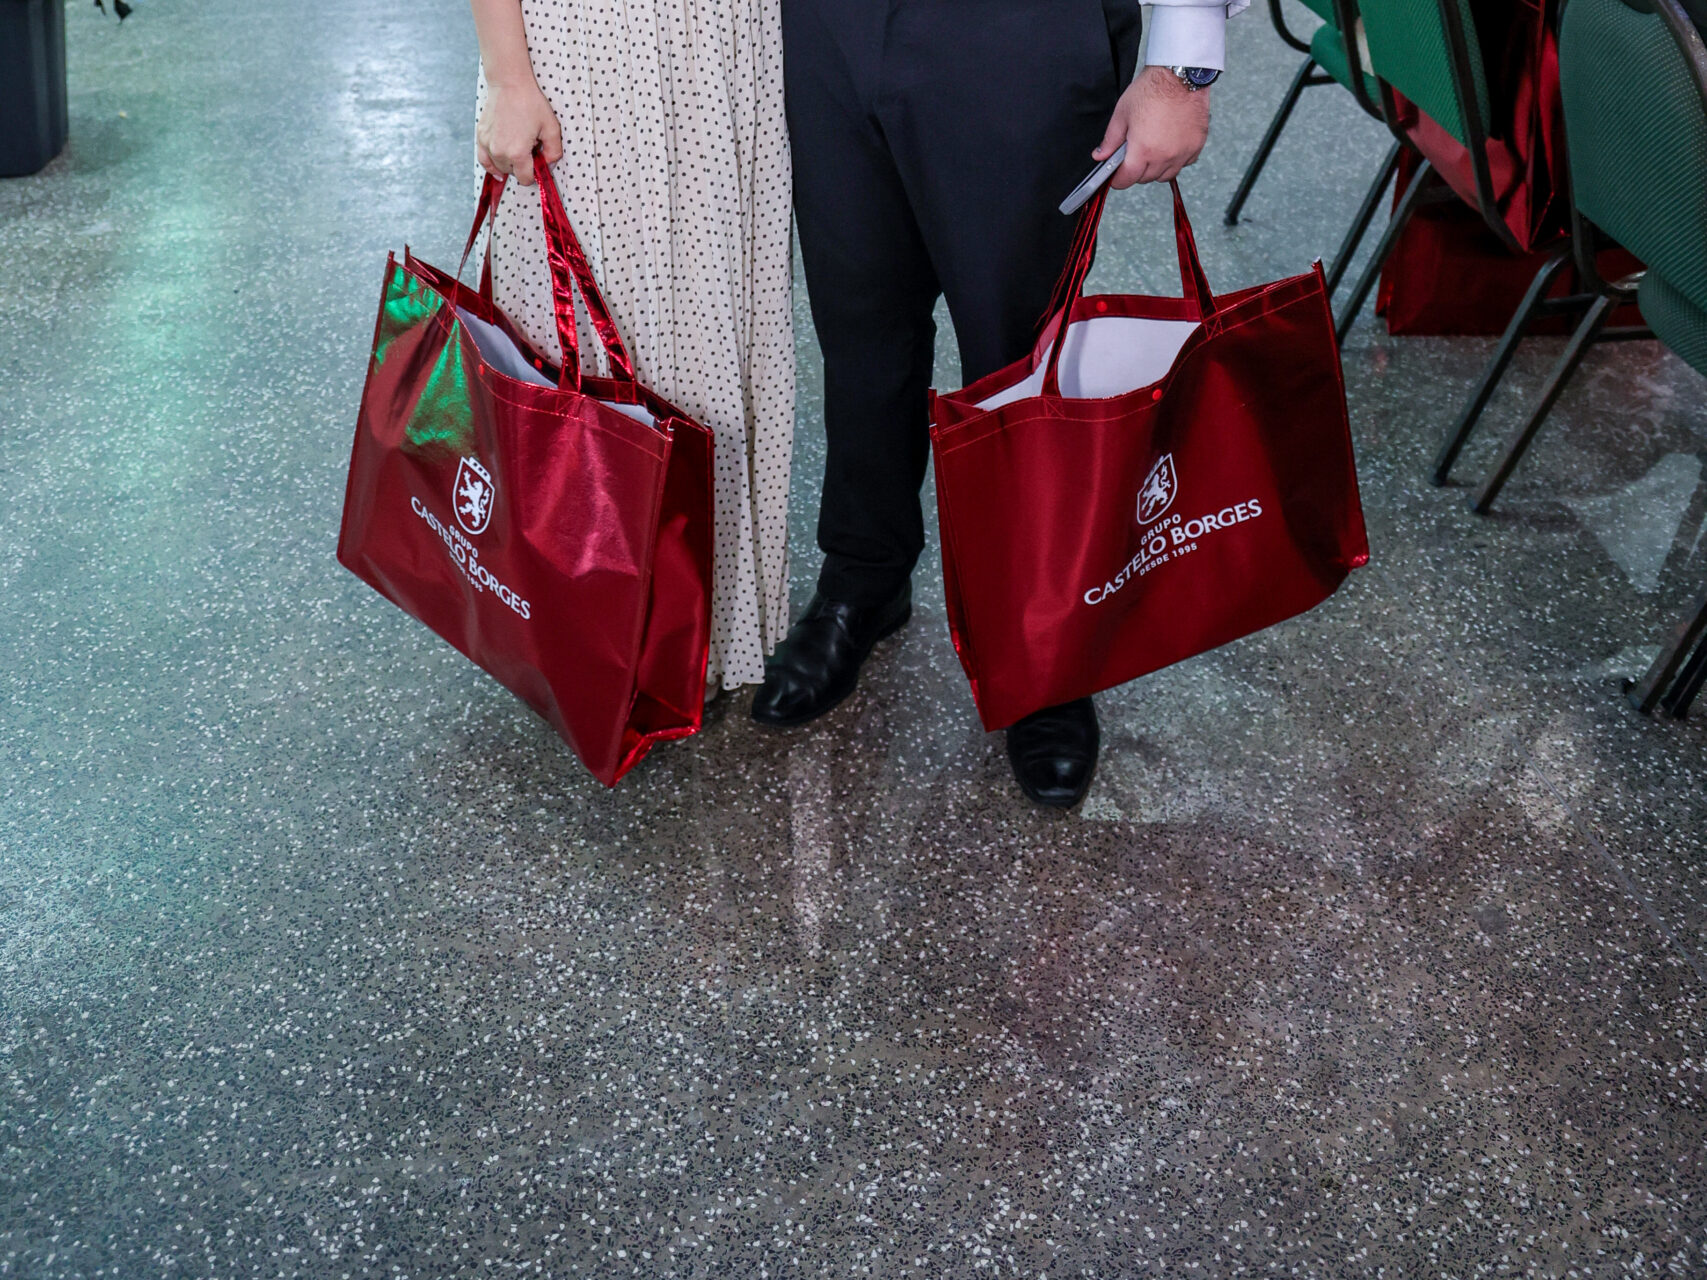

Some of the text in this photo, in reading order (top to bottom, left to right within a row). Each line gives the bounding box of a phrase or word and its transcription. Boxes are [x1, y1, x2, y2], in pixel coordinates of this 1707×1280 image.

[449, 524, 479, 559] GRUPO
[1140, 513, 1182, 546] GRUPO
[410, 496, 531, 620] CASTELO BORGES
[1083, 498, 1263, 606] CASTELO BORGES
[1139, 542, 1198, 577] DESDE 1995
